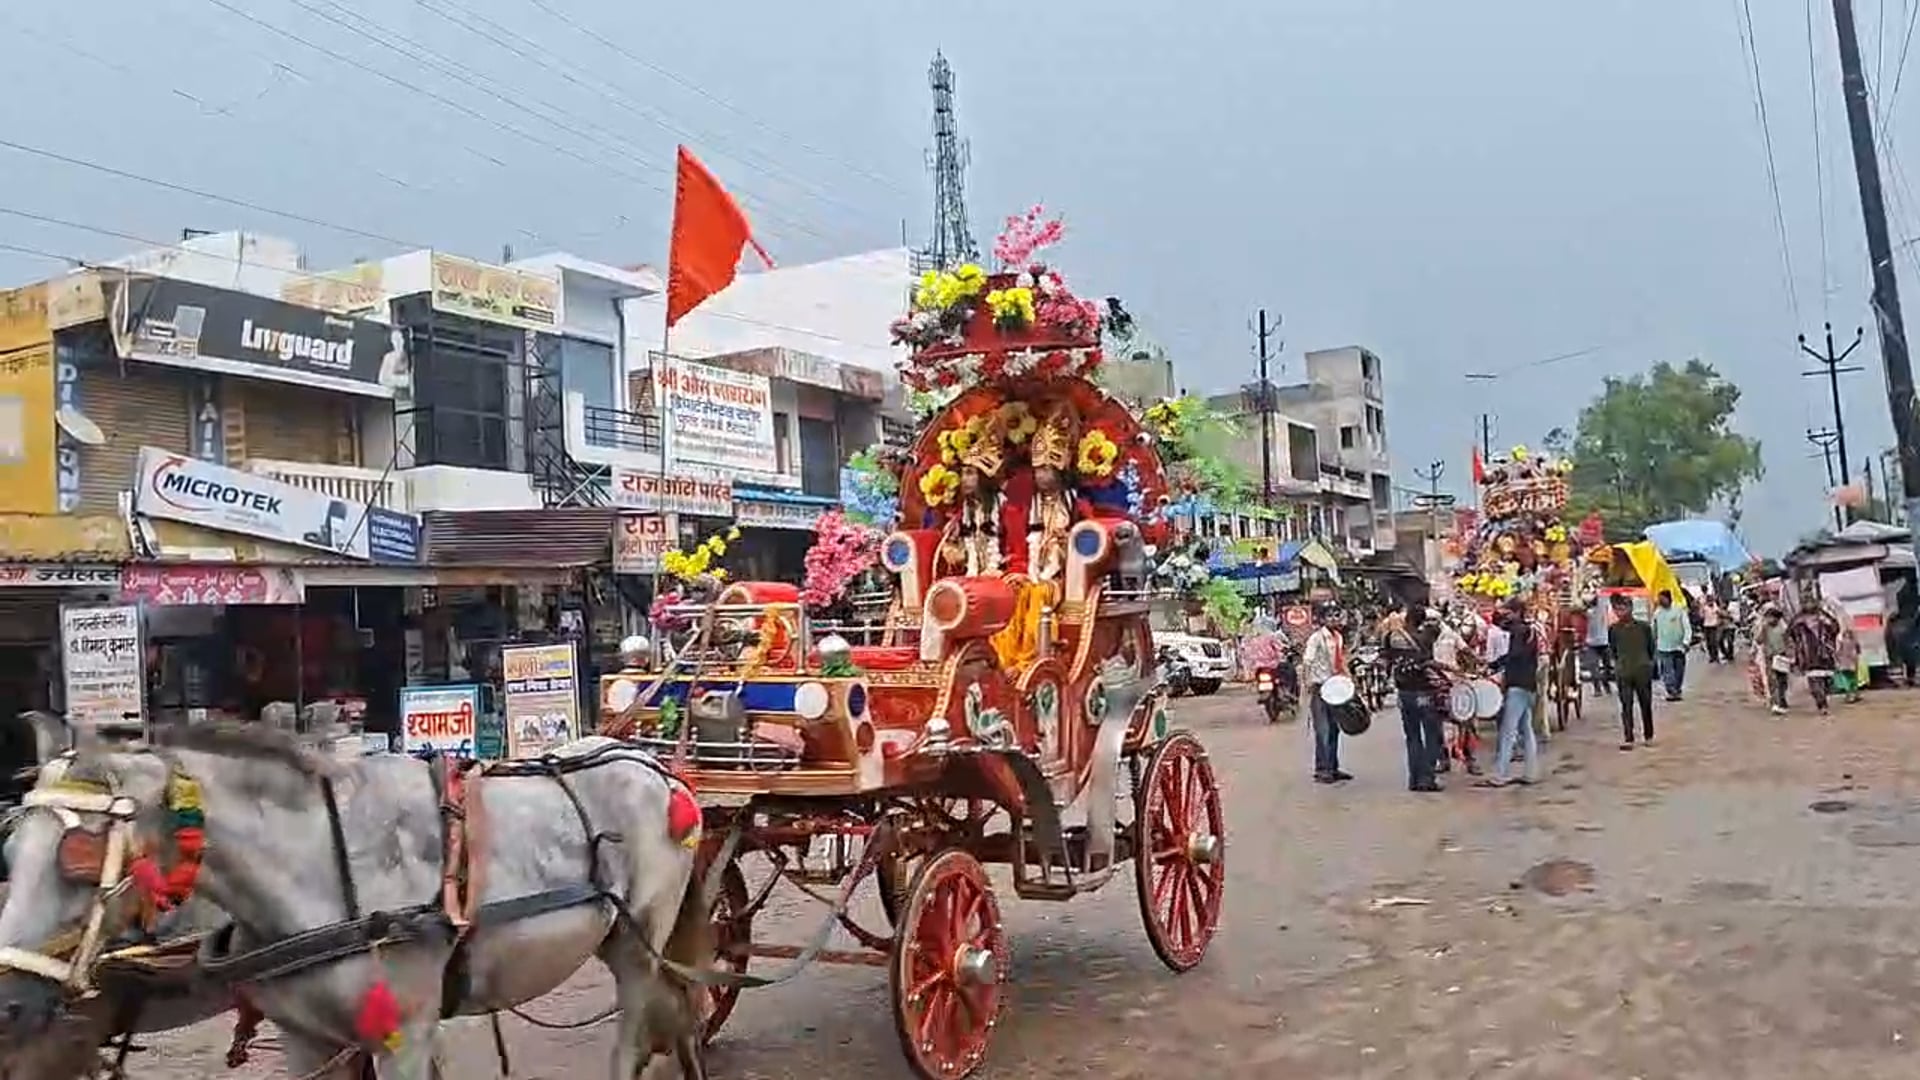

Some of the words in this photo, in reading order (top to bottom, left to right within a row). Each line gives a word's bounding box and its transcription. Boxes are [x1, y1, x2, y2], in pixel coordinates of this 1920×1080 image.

[241, 319, 355, 364] Livguard
[163, 473, 284, 515] MICROTEK
[620, 473, 659, 493] राज
[624, 515, 667, 535] राज
[407, 702, 472, 736] श्यामजी
